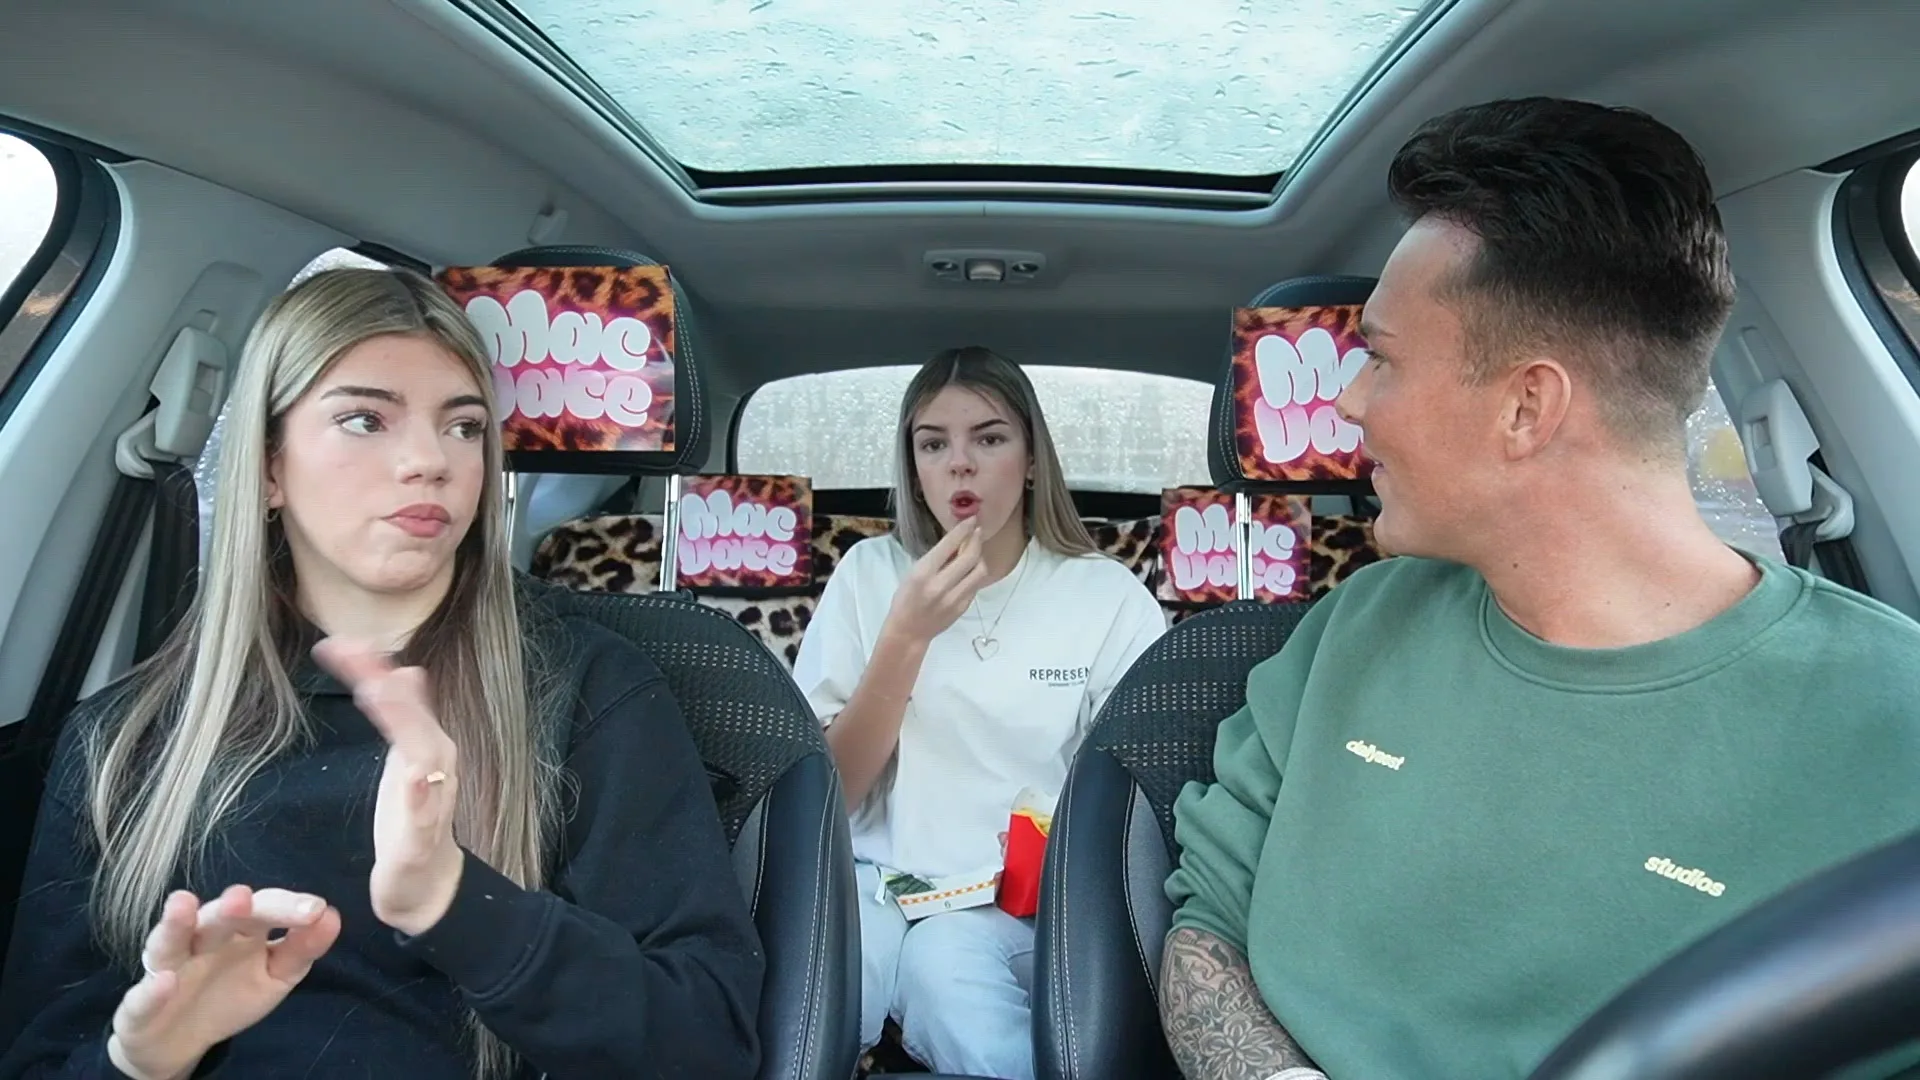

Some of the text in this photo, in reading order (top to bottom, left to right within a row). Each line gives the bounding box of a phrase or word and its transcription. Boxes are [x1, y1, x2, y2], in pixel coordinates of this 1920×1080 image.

[681, 489, 797, 542] Mac
[1029, 665, 1090, 681] REPRESEN
[1644, 856, 1726, 897] studios
